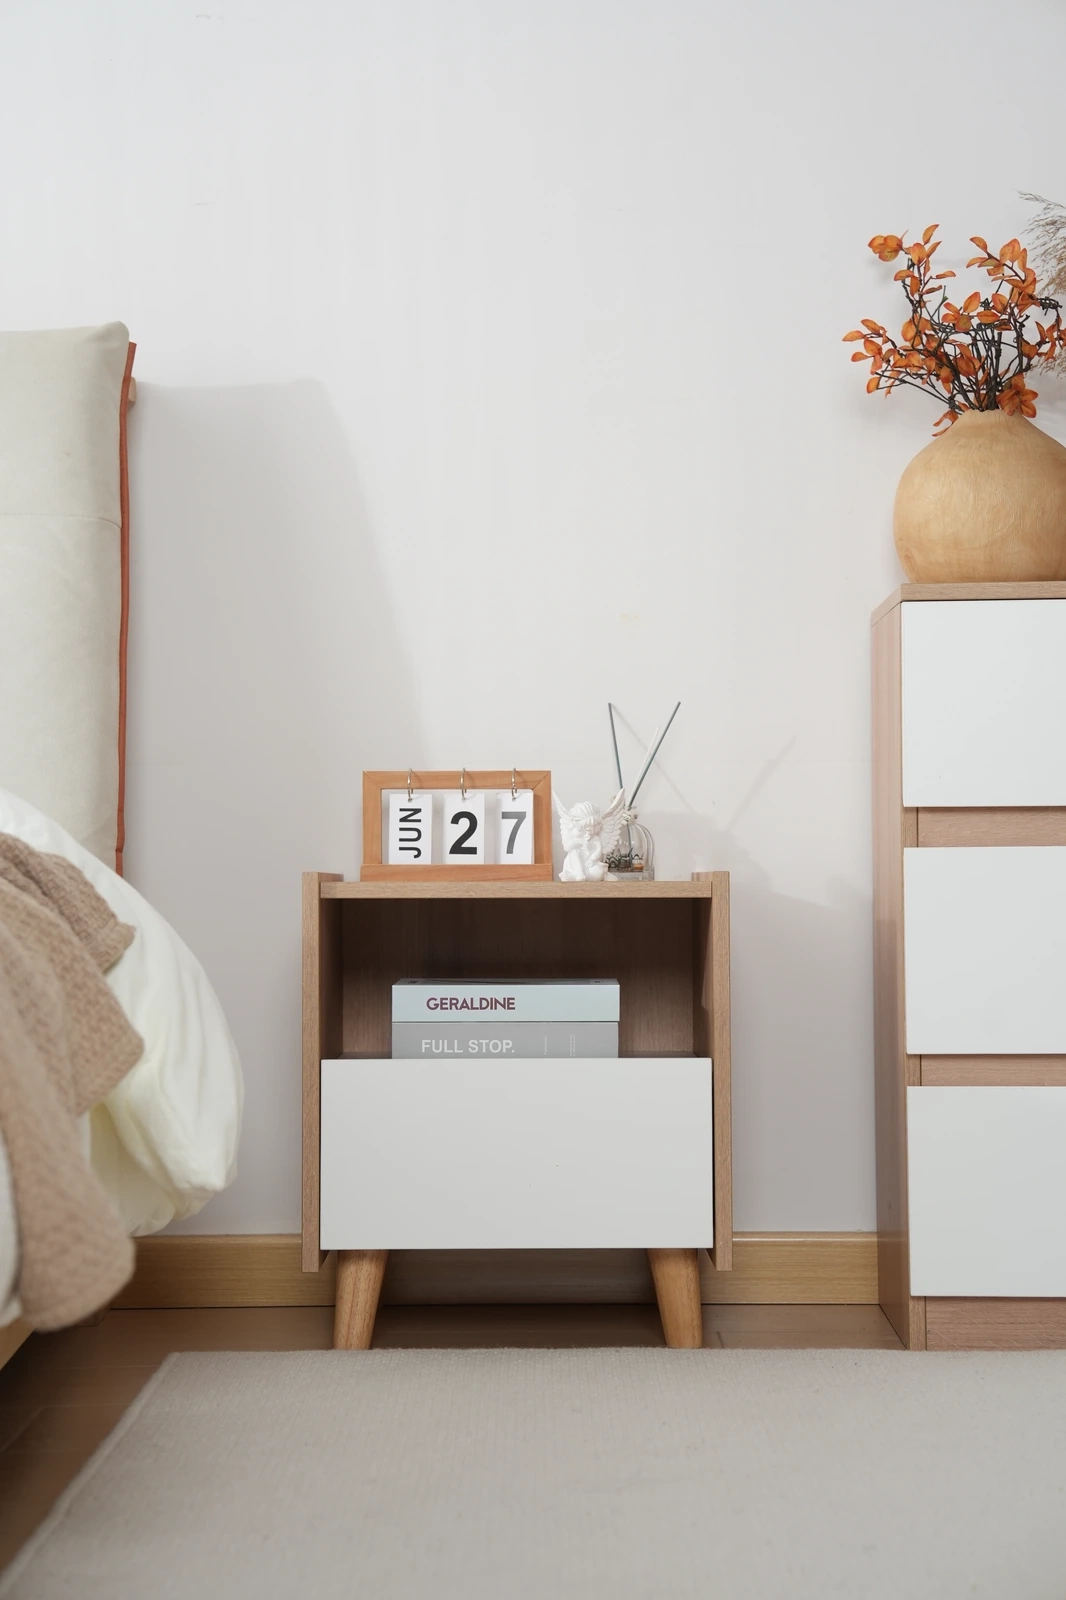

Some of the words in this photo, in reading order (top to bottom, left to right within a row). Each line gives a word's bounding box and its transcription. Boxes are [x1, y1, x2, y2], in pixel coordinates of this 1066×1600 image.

[398, 807, 422, 859] JUN
[448, 811, 478, 855] 2
[501, 811, 527, 855] 7
[426, 997, 516, 1011] GERALDINE
[421, 1039, 464, 1053] FULL
[468, 1039, 515, 1053] STOP.
